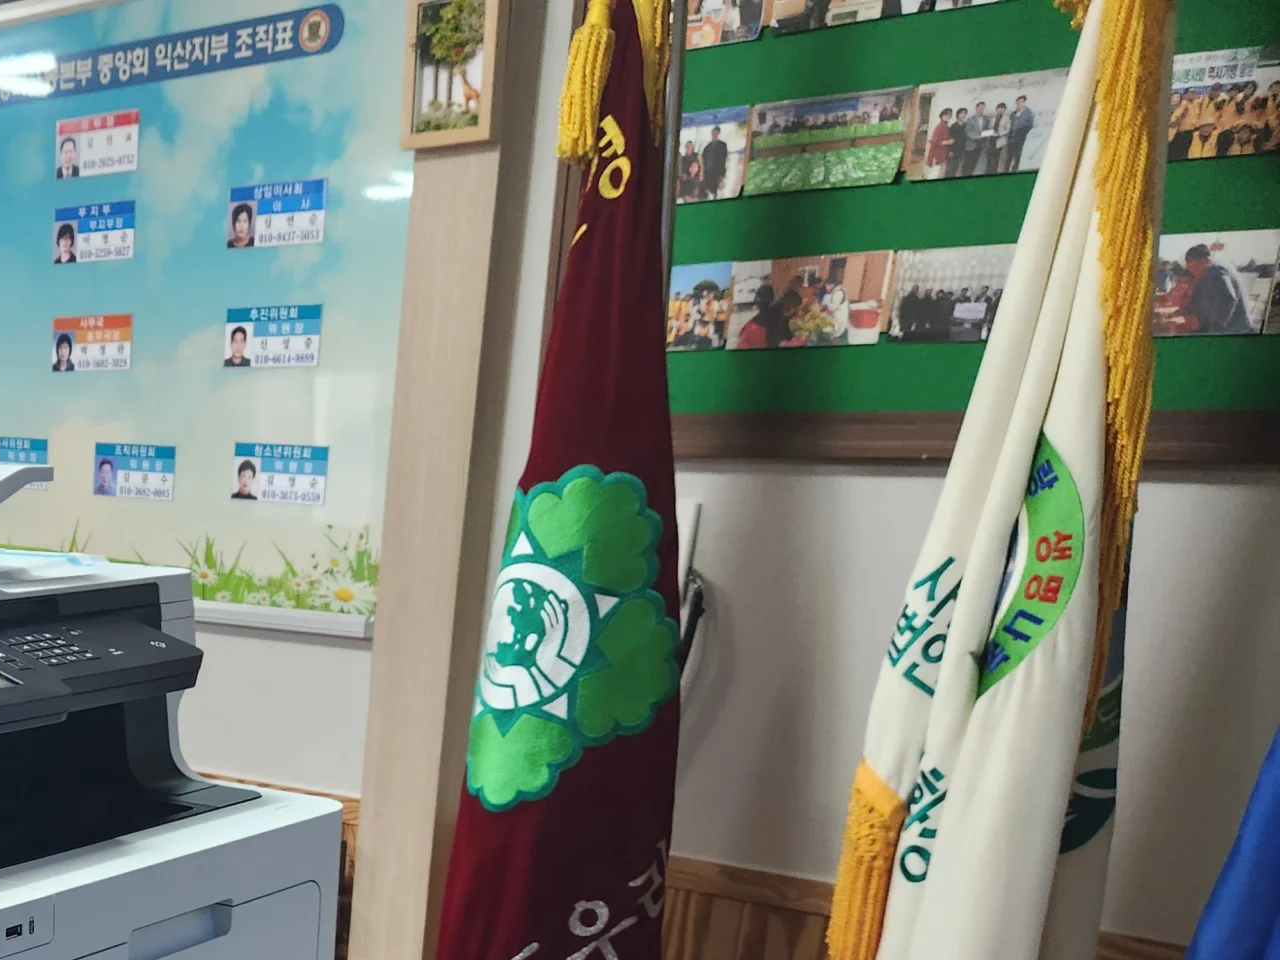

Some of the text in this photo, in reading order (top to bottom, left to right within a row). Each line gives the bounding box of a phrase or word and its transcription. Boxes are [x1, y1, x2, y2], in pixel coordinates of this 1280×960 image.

[97, 48, 149, 86] 중앙회
[155, 36, 230, 73] 익산지부
[234, 20, 295, 60] 조직표
[249, 306, 298, 321] 추진위원회
[114, 444, 155, 457] 조직위원회
[254, 444, 311, 459] 청소년위원회
[1024, 529, 1073, 604] 생명
